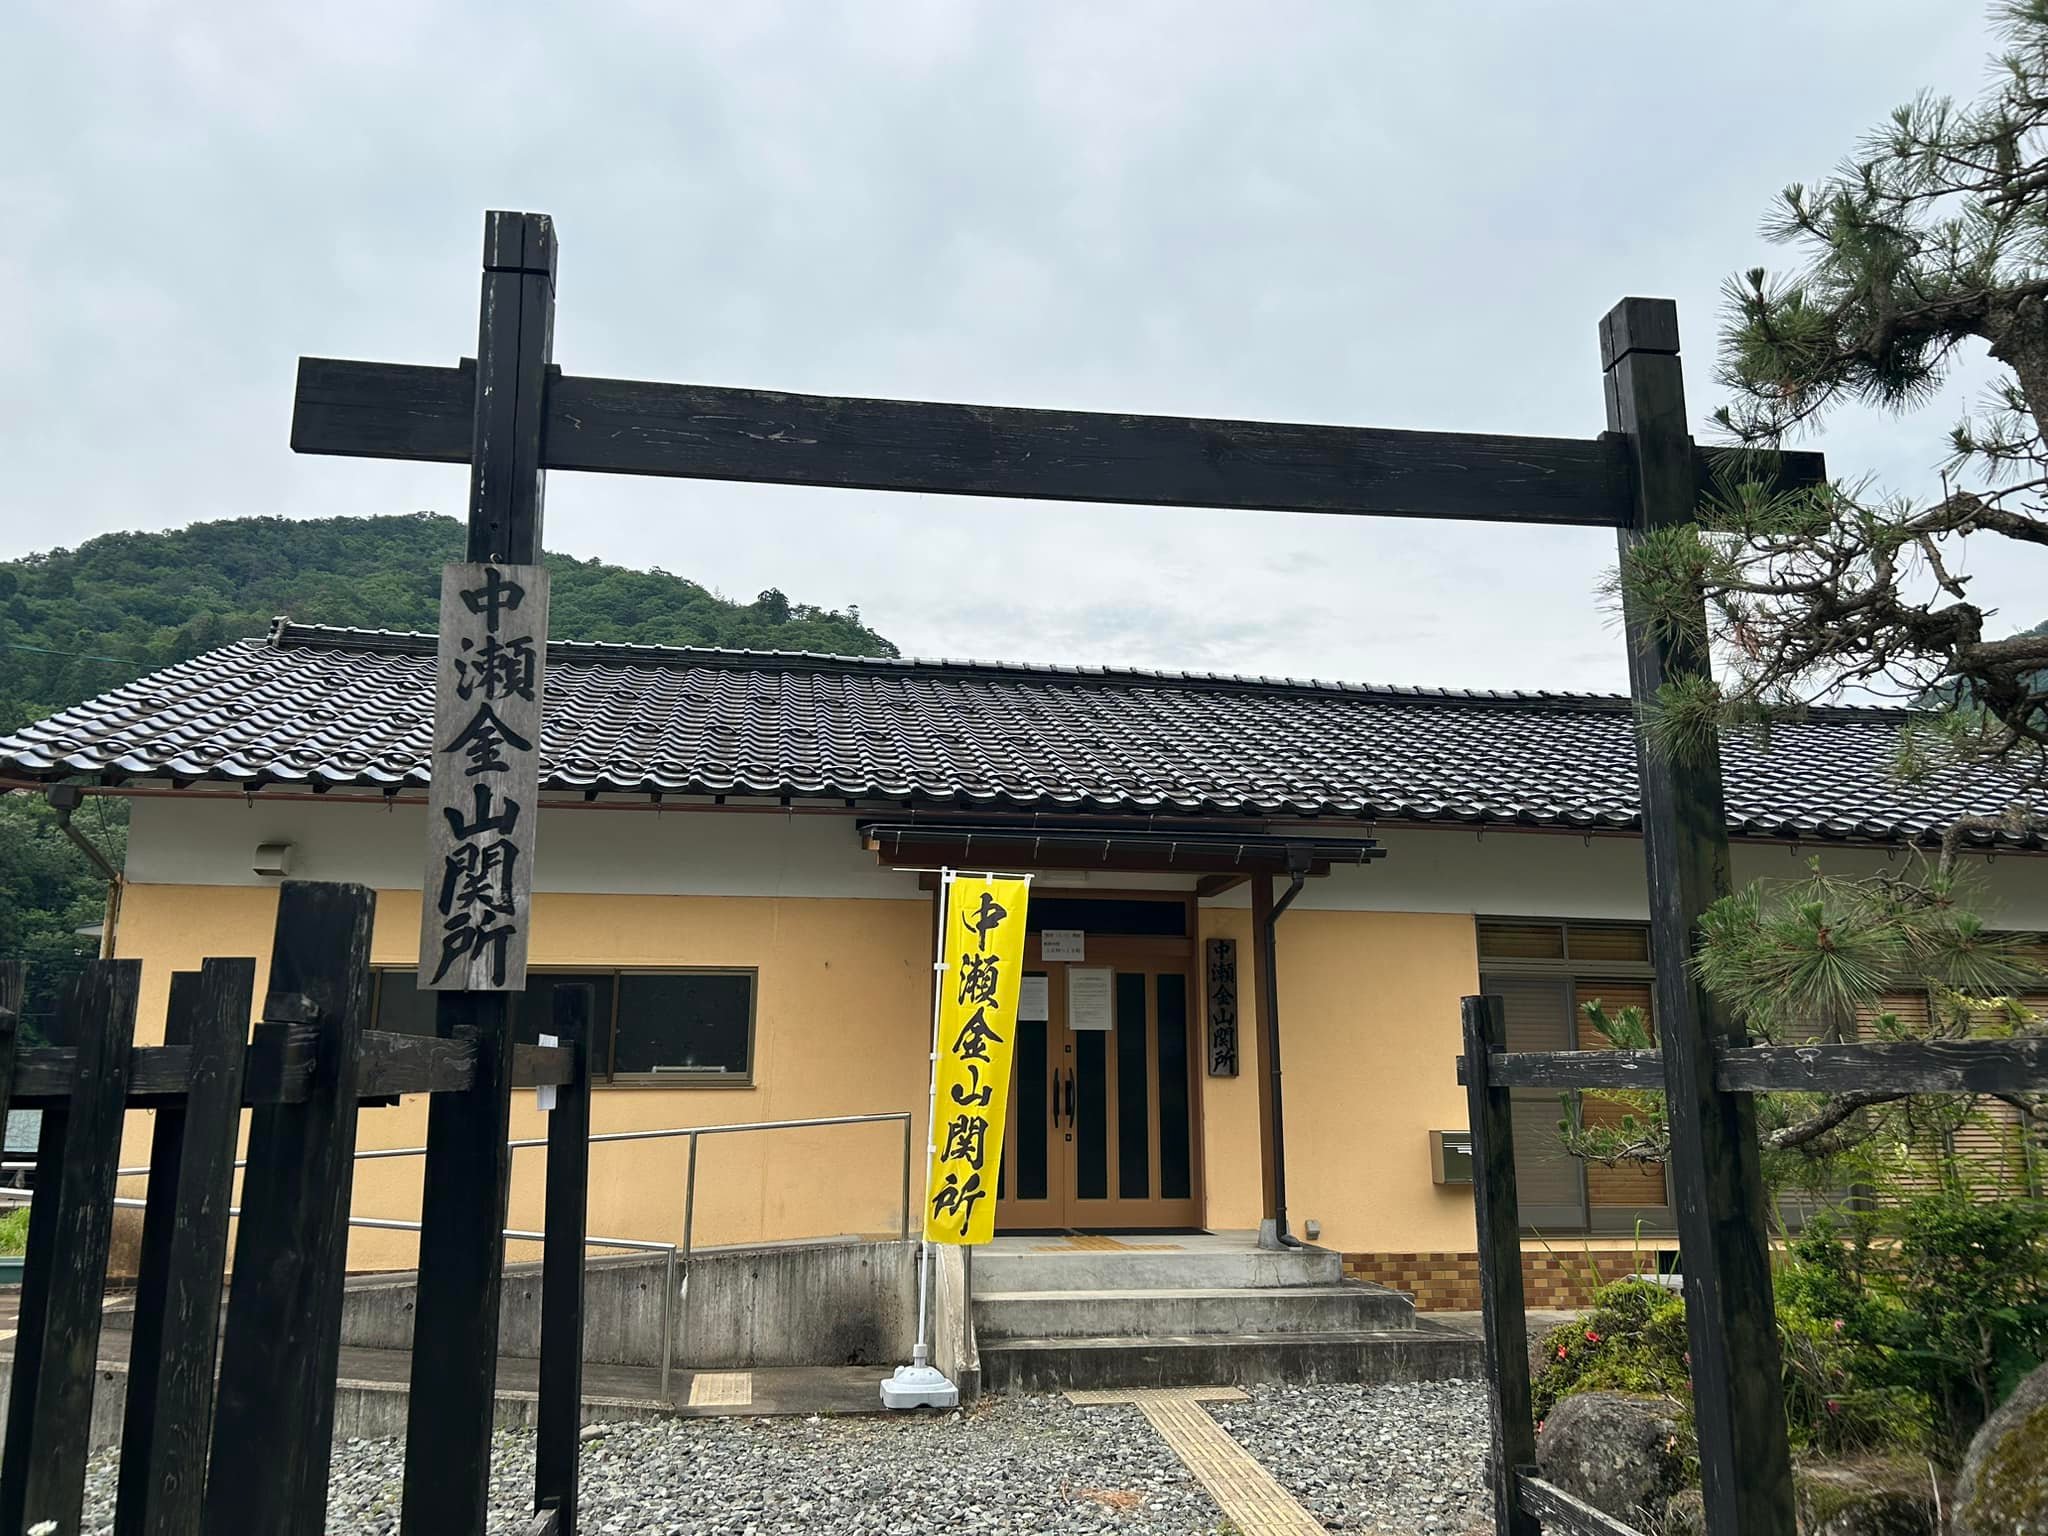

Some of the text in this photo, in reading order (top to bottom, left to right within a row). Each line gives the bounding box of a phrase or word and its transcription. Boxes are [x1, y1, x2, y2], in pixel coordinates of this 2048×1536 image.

[430, 567, 536, 987] 中瀬金山関所
[932, 892, 1008, 1236] 中瀬金山関所
[1211, 940, 1236, 1075] 中瀬金山関所
